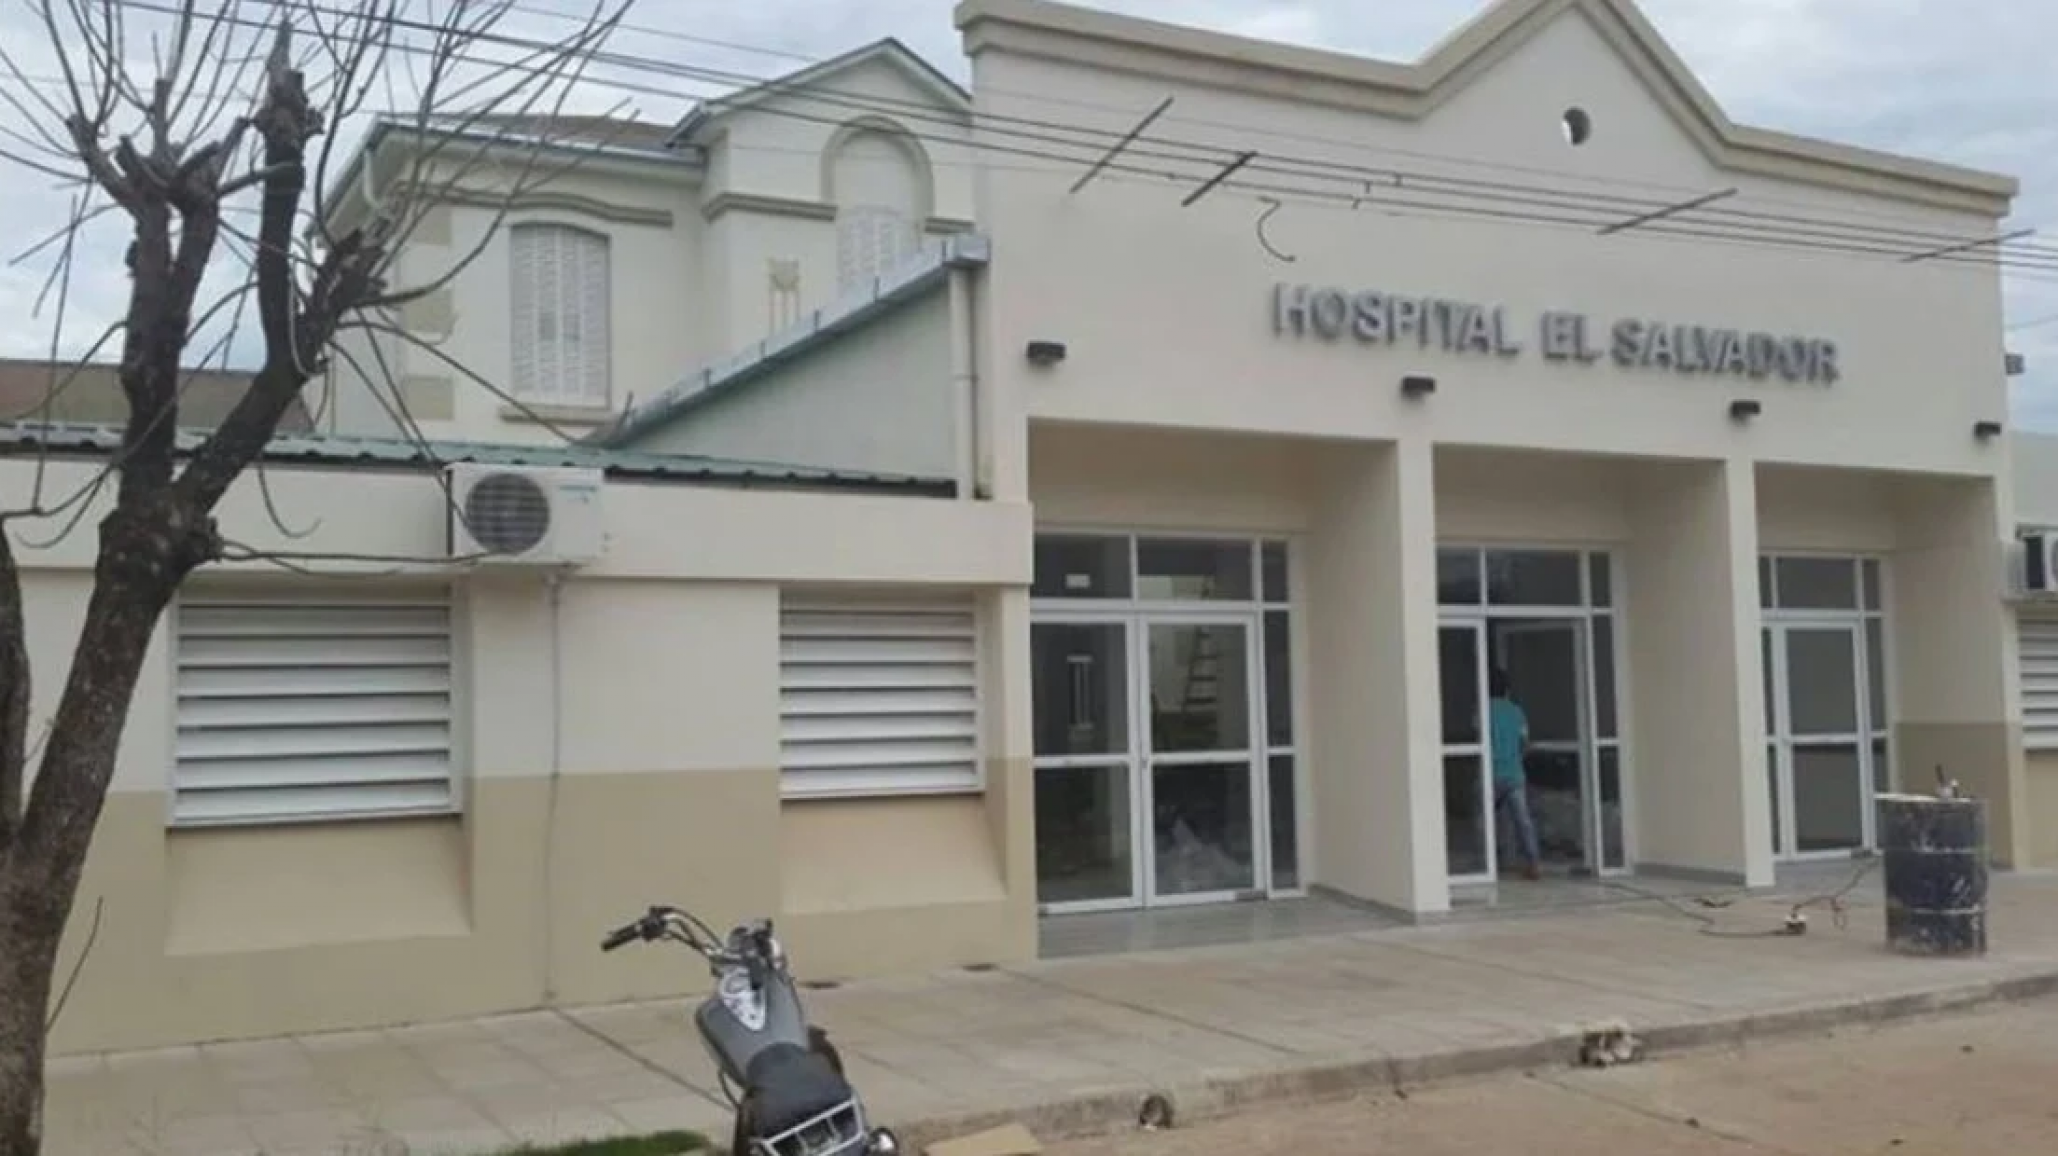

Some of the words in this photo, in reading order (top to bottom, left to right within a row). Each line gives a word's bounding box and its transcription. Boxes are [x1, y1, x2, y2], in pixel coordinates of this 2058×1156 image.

[1273, 284, 1518, 358] HOSPITAL
[1542, 311, 1600, 362] EL
[1612, 319, 1839, 385] SALVADOR
